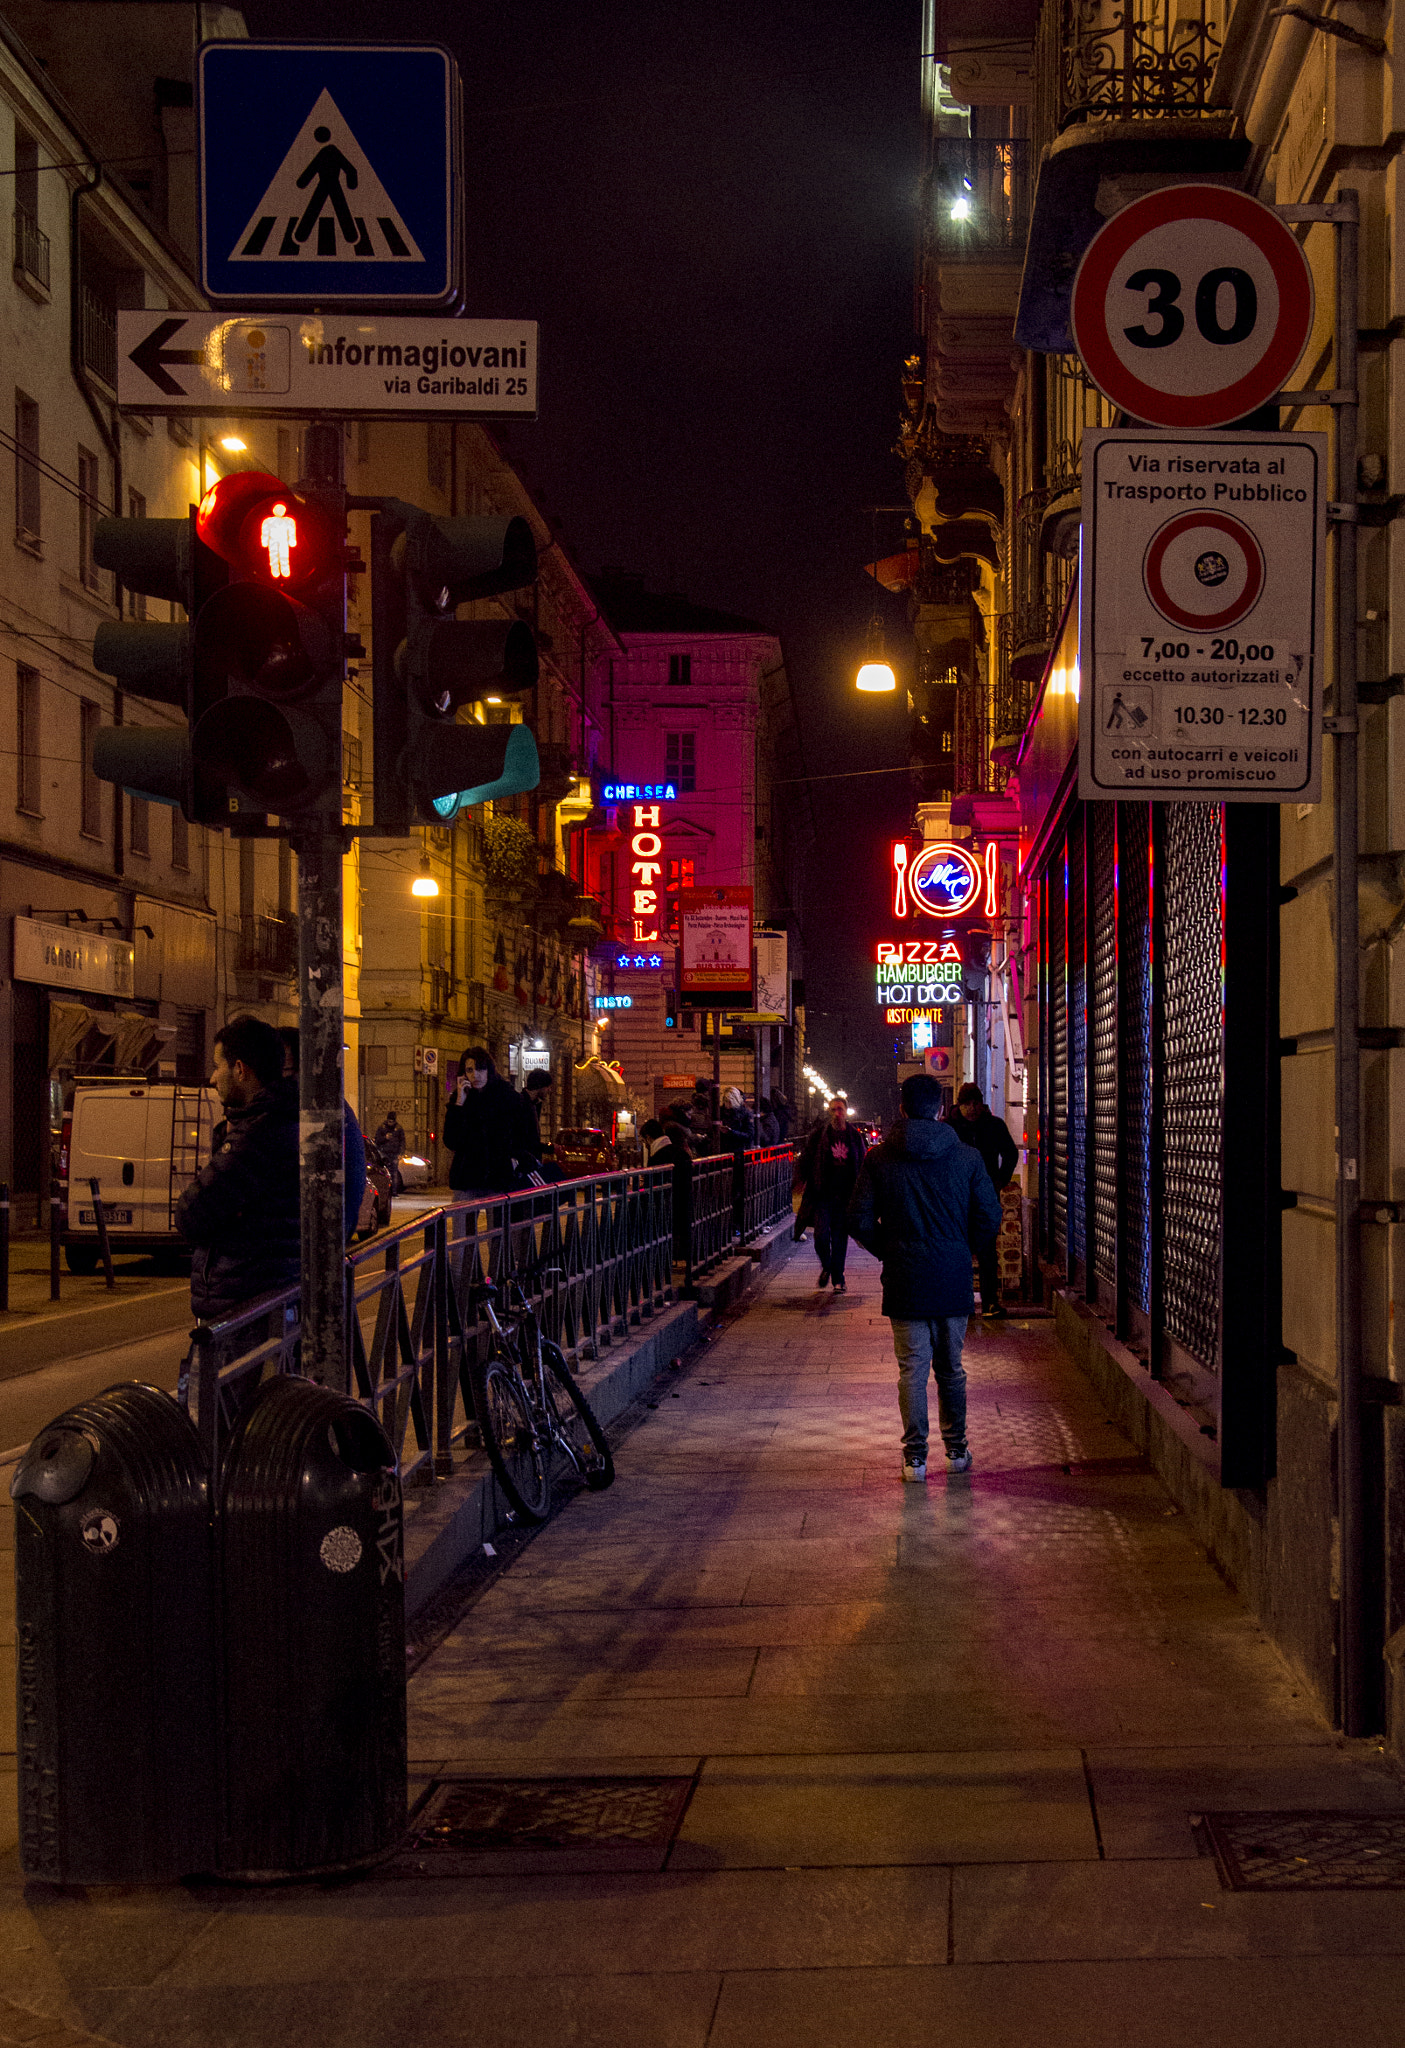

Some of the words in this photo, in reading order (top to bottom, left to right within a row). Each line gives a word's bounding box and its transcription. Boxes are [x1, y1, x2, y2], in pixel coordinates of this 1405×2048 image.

[1123, 267, 1257, 348] 30
[308, 336, 527, 374] informagiovani
[384, 377, 410, 394] via
[417, 375, 500, 396] Garibaldi
[505, 377, 528, 396] 25
[1128, 455, 1160, 472] Via
[1168, 456, 1260, 474] riservata
[1267, 458, 1285, 474] al
[1104, 481, 1206, 503] Trasporto
[1214, 483, 1307, 502] Pubblico
[1122, 670, 1185, 682] eccetto
[1191, 670, 1279, 683] autorizzati
[1285, 673, 1294, 683] e
[1111, 749, 1141, 760] con
[1147, 748, 1223, 761] autocarri
[1229, 752, 1238, 762] e
[1244, 749, 1298, 762] veicoli
[1125, 766, 1144, 779] ad
[1151, 769, 1181, 780] uso
[1187, 767, 1276, 782] promiscuo
[604, 784, 676, 800] CHELSEA
[229, 798, 239, 812] B
[631, 805, 662, 942] HOTEL
[877, 942, 961, 963] PIZZA
[877, 962, 962, 983] HAMBURGER
[595, 995, 632, 1008] RISTO
[877, 984, 915, 1004] HOT
[917, 984, 961, 1003] DOG
[887, 1008, 943, 1023] RISTORANTE
